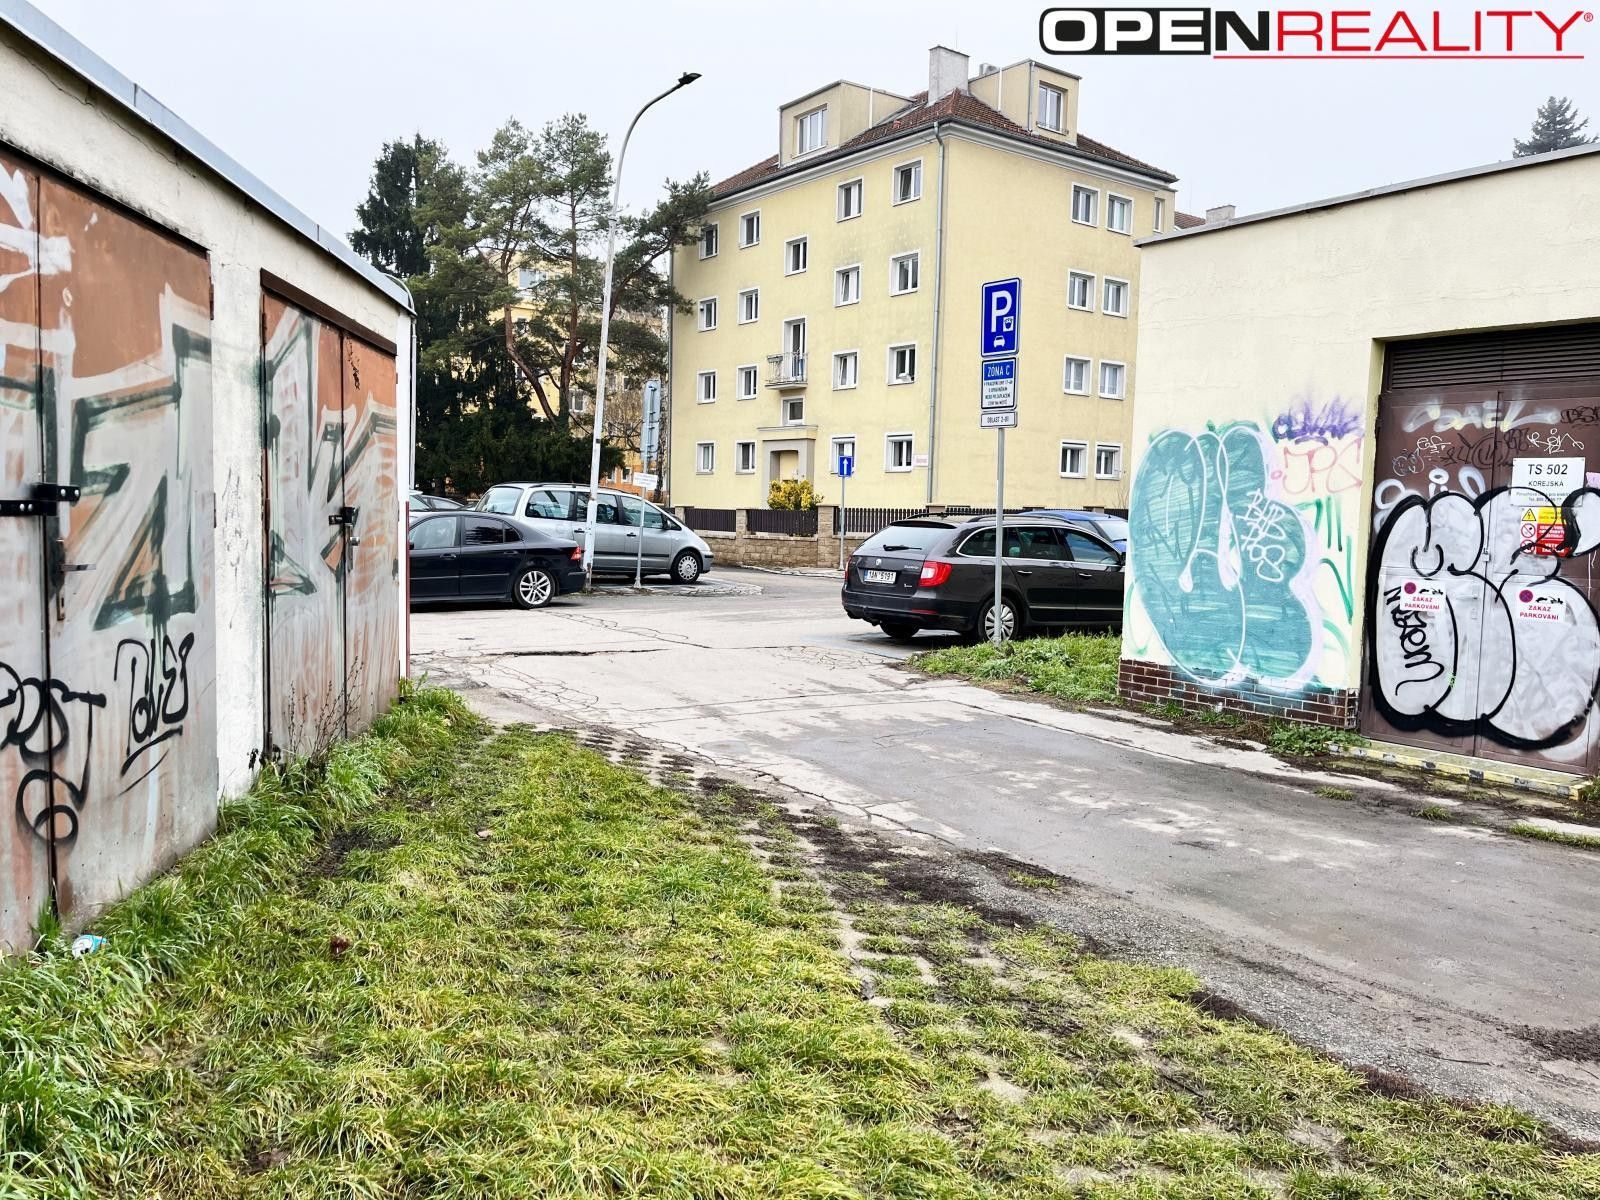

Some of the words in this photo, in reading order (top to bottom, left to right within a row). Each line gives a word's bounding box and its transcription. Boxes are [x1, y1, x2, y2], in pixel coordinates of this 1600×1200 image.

[990, 290, 1013, 333] P
[1527, 464, 1543, 475] TS
[1546, 464, 1568, 475] 502
